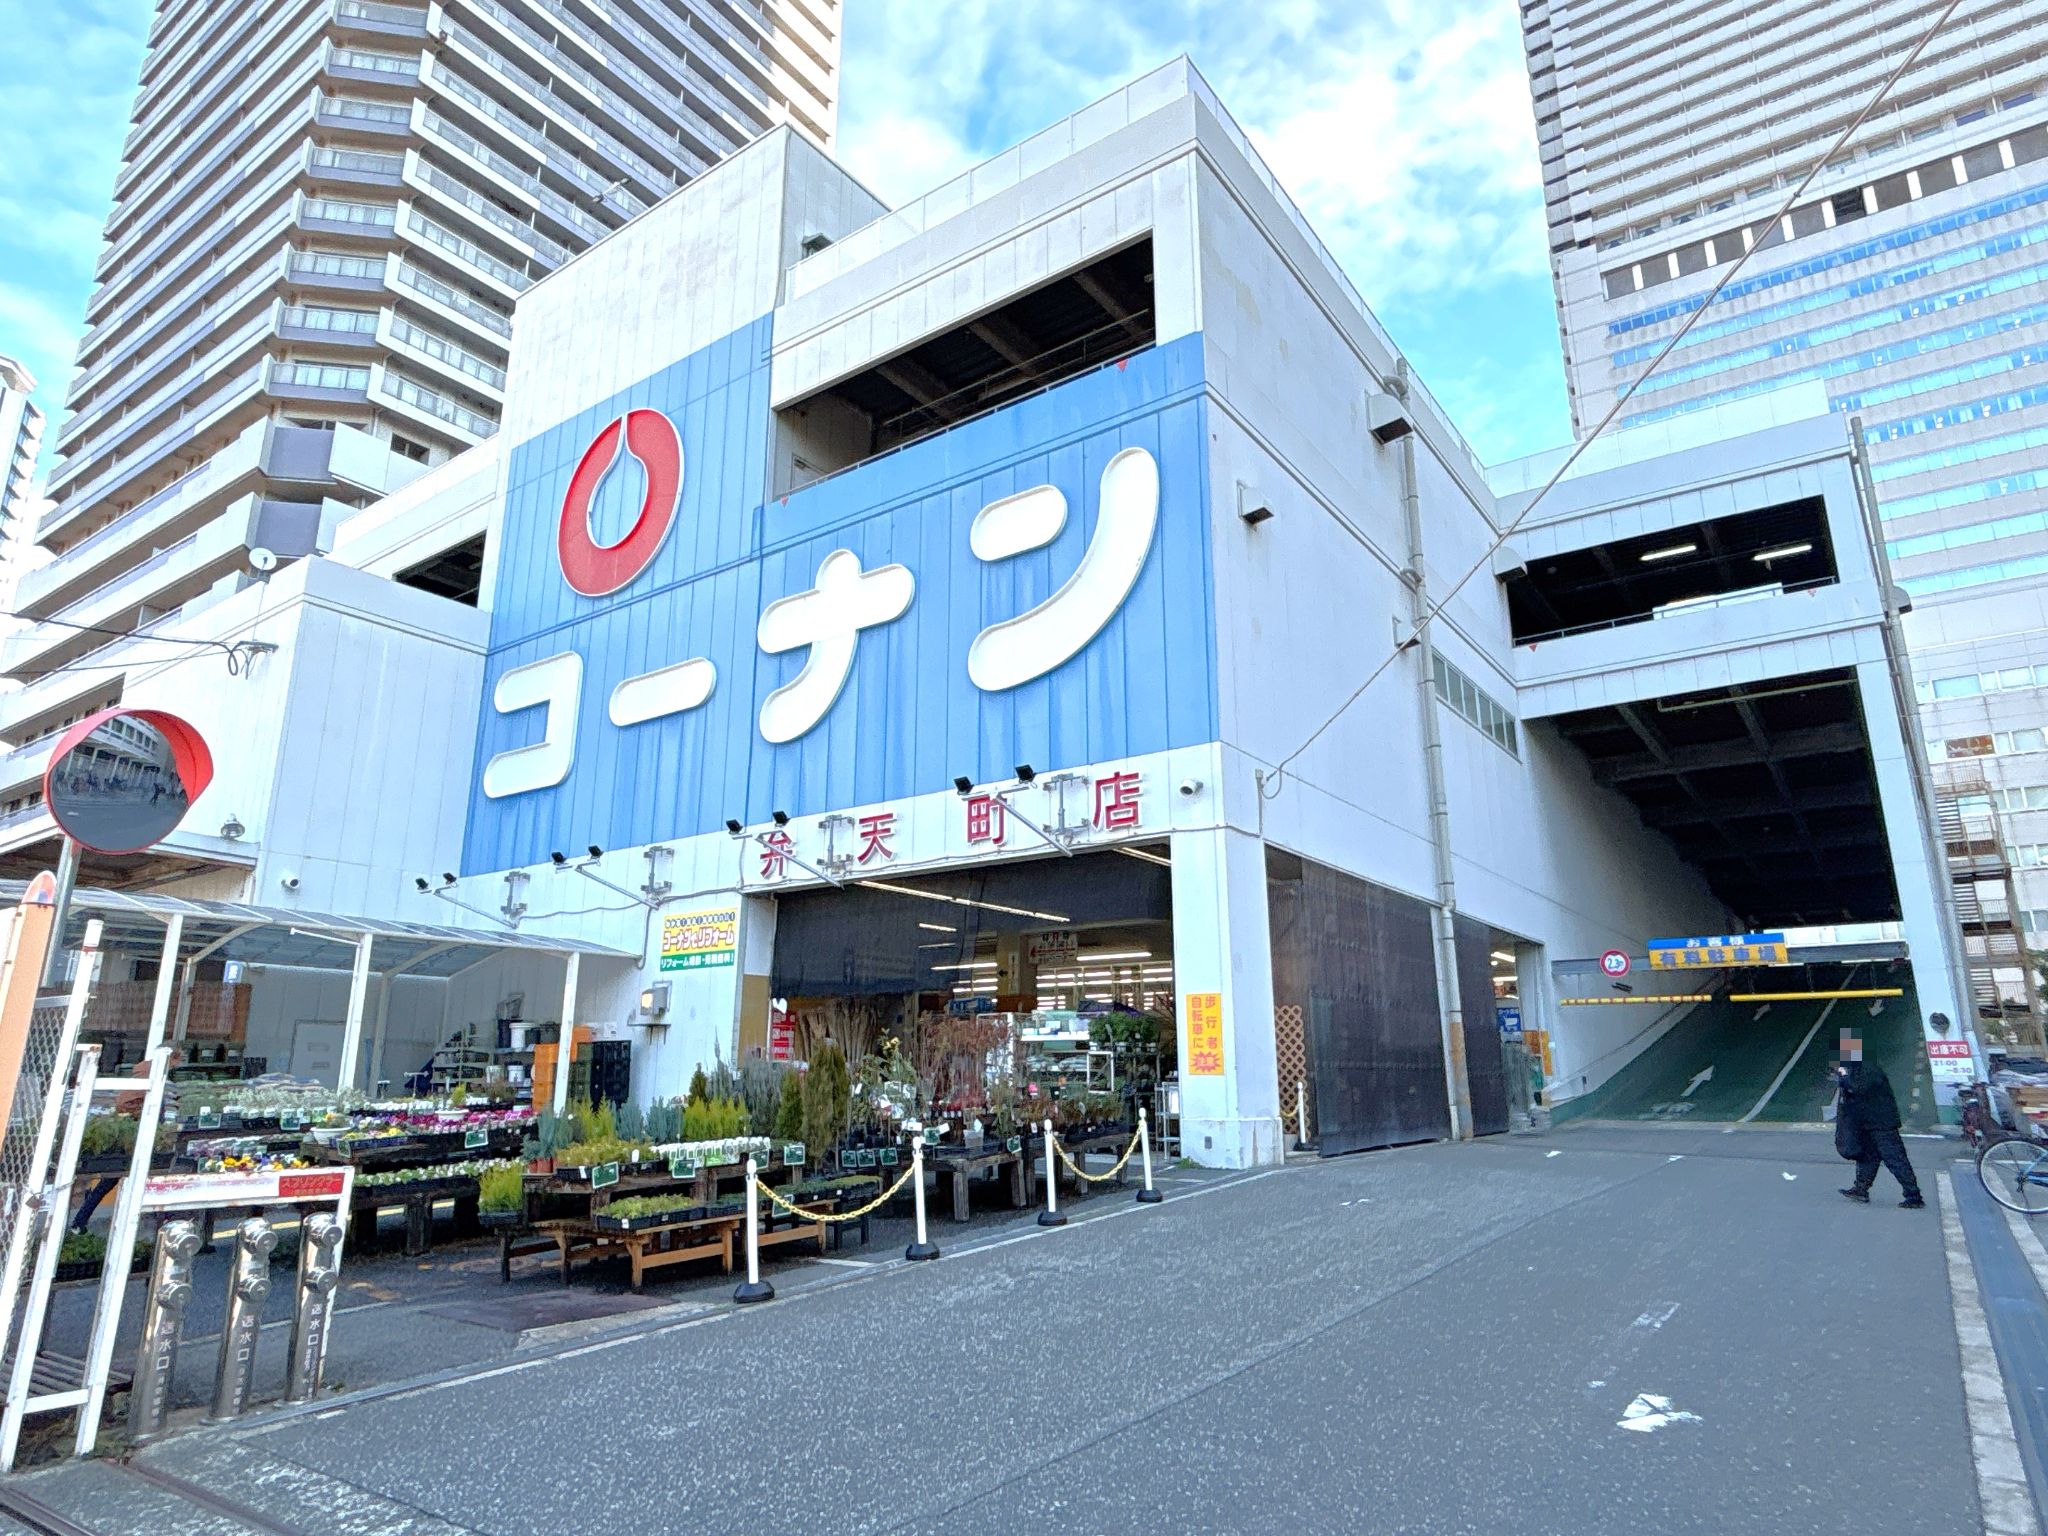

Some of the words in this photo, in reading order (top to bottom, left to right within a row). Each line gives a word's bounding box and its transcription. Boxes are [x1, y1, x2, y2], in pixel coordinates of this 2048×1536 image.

[484, 447, 1159, 798] コーナン
[760, 771, 1142, 878] 弁天町店
[1191, 996, 1204, 1049] 自転車に
[1204, 996, 1218, 1049] 歩行者
[156, 1321, 174, 1371] 送水口
[236, 1315, 254, 1362] 送水口
[306, 1303, 322, 1346] 送水口
